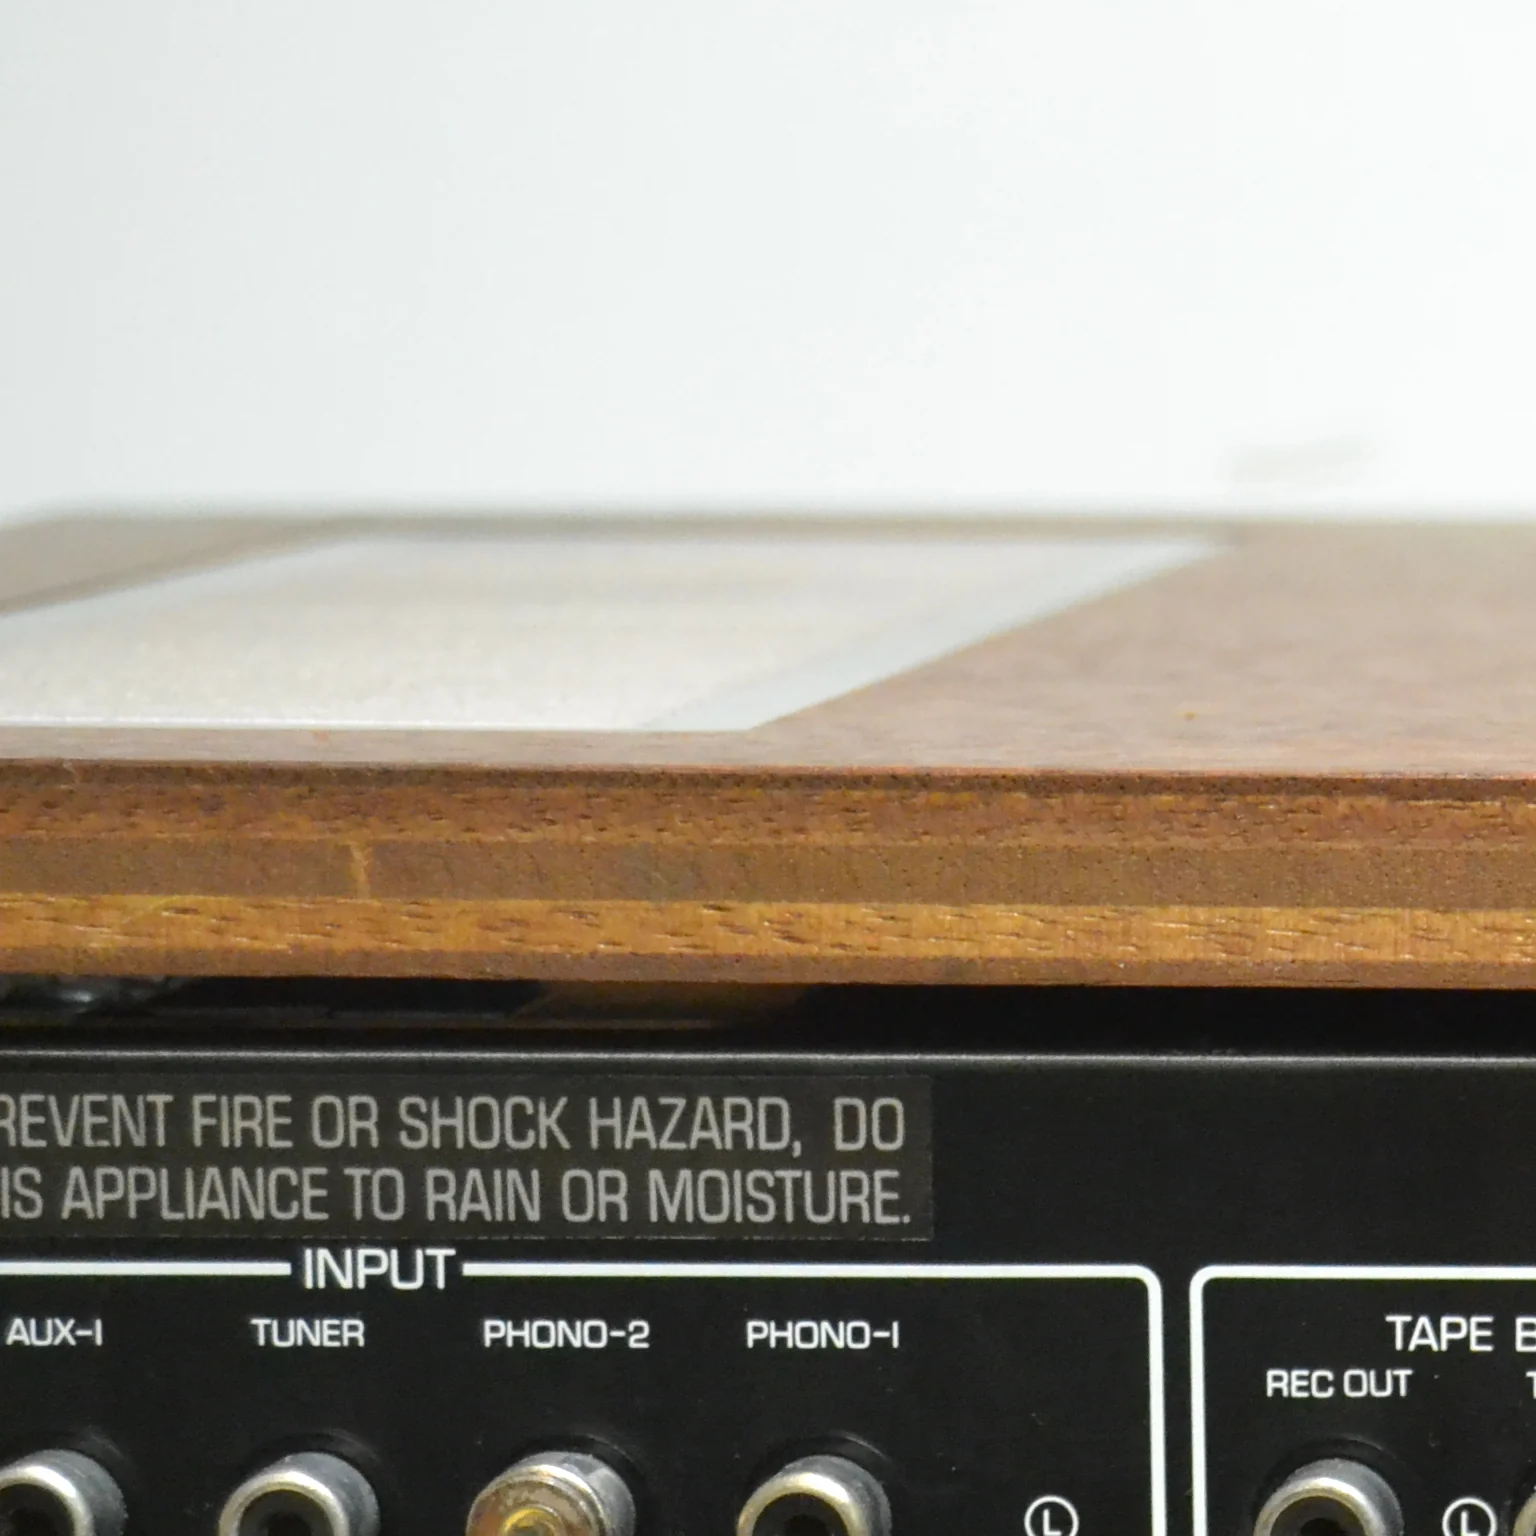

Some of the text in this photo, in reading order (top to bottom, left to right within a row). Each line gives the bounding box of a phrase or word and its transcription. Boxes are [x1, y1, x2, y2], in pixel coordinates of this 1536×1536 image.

[193, 1094, 295, 1150] FIRE
[312, 1095, 381, 1150] OR
[399, 1096, 572, 1151] SHOCK
[590, 1097, 803, 1159] HAZARD,
[834, 1098, 906, 1153] DO
[1, 1166, 912, 1226] IS APPLIANCE TO RAIN OR MOISTURE.
[304, 1248, 458, 1291] INPUT
[251, 1318, 366, 1349] TUNER
[484, 1320, 651, 1350] PHONO-2
[1386, 1315, 1495, 1353] TAPE
[1267, 1369, 1414, 1400] REC OUT
